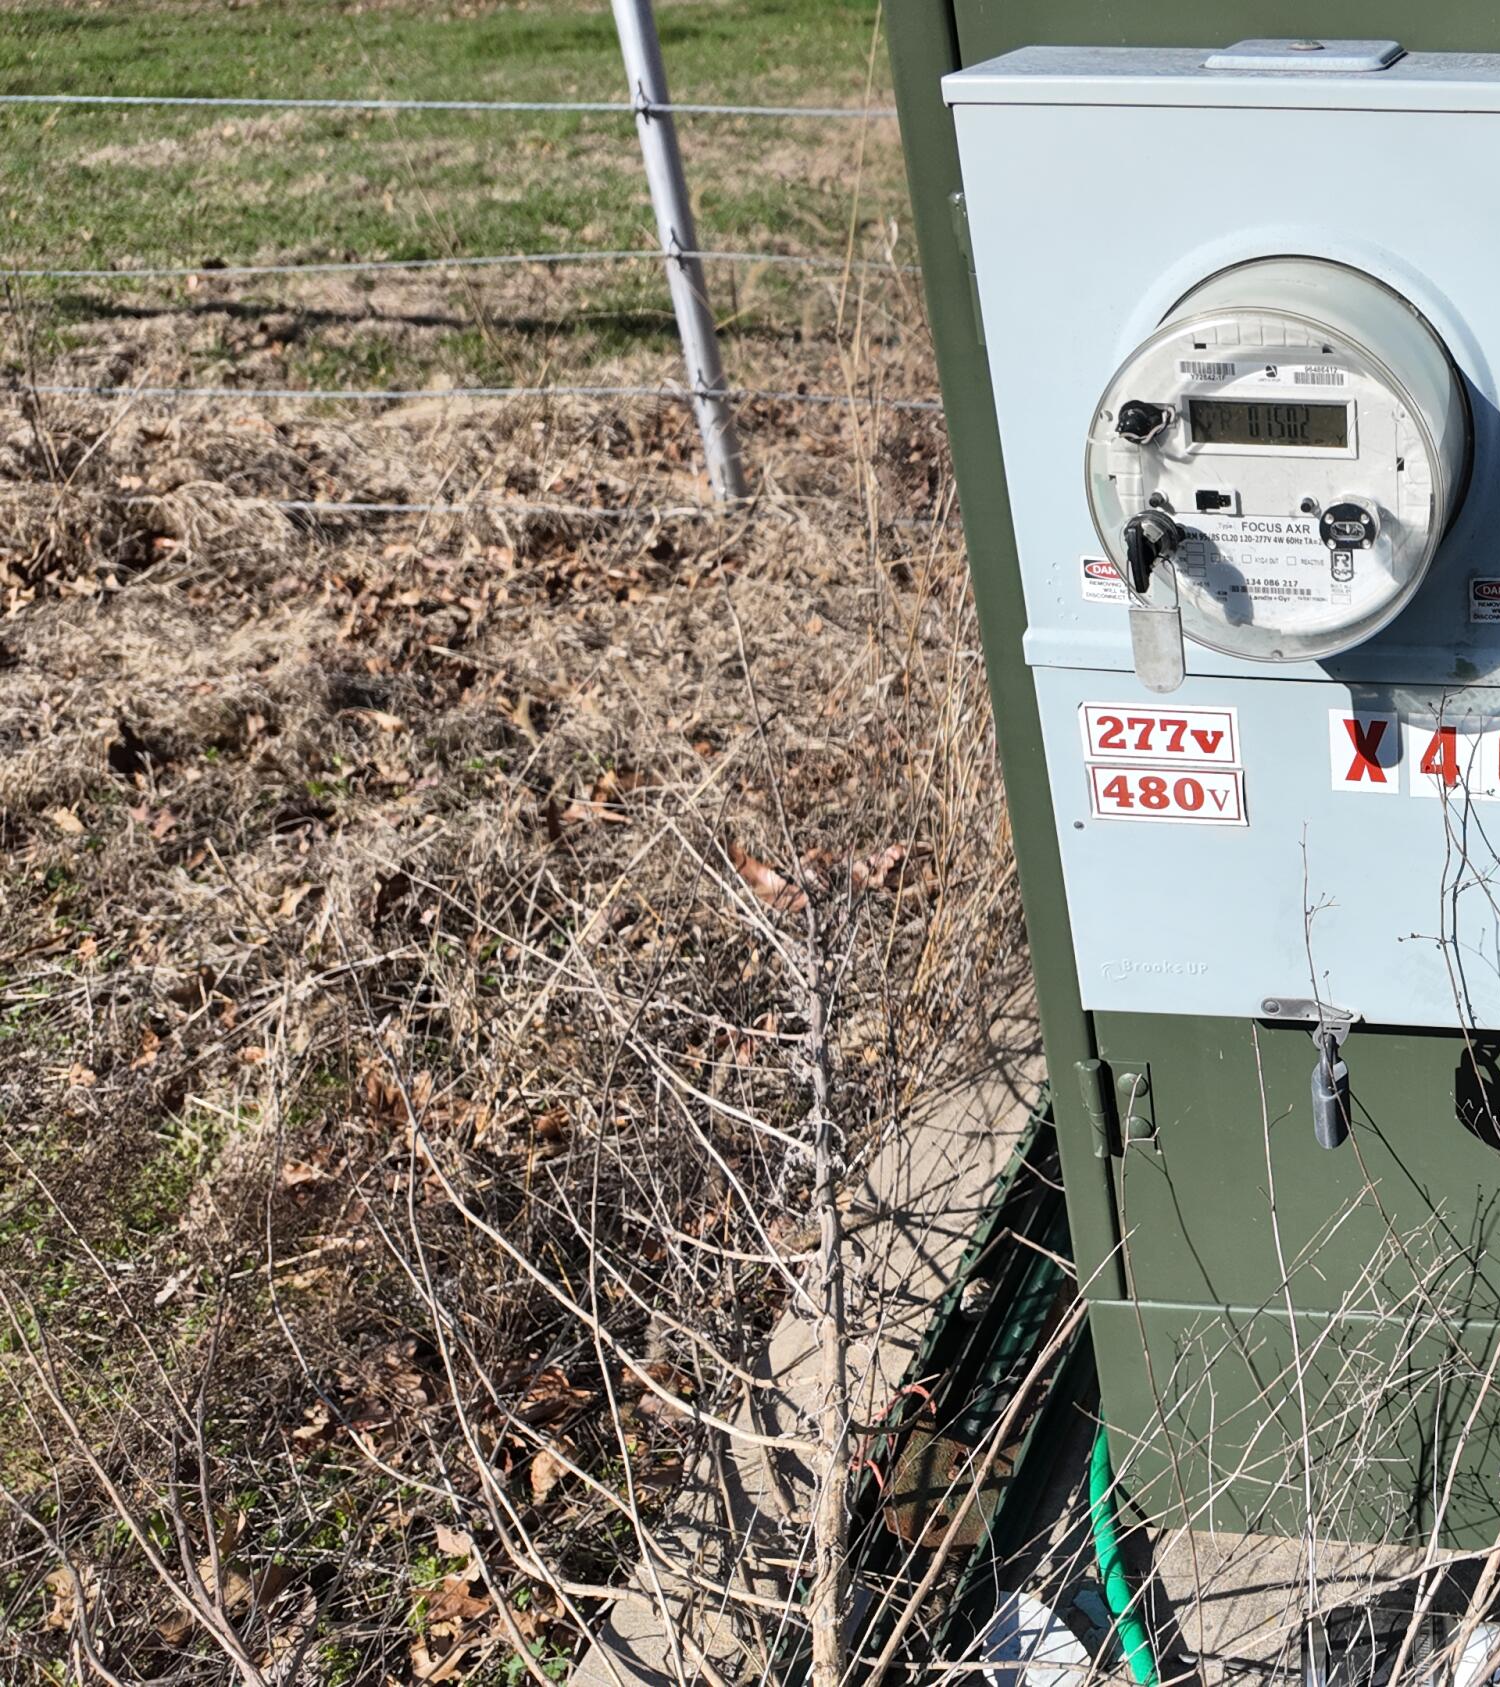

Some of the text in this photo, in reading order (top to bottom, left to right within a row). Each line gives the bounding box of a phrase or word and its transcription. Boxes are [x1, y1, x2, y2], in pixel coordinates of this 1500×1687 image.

[1241, 521, 1283, 534] FOCUS
[1285, 523, 1311, 535] AXR
[1221, 533, 1239, 542] CL20
[1240, 534, 1272, 543] 120-277V
[1273, 535, 1284, 544] 4W
[1286, 536, 1303, 545] 60Hz
[1092, 565, 1118, 576] DAN
[1282, 580, 1299, 588] 217
